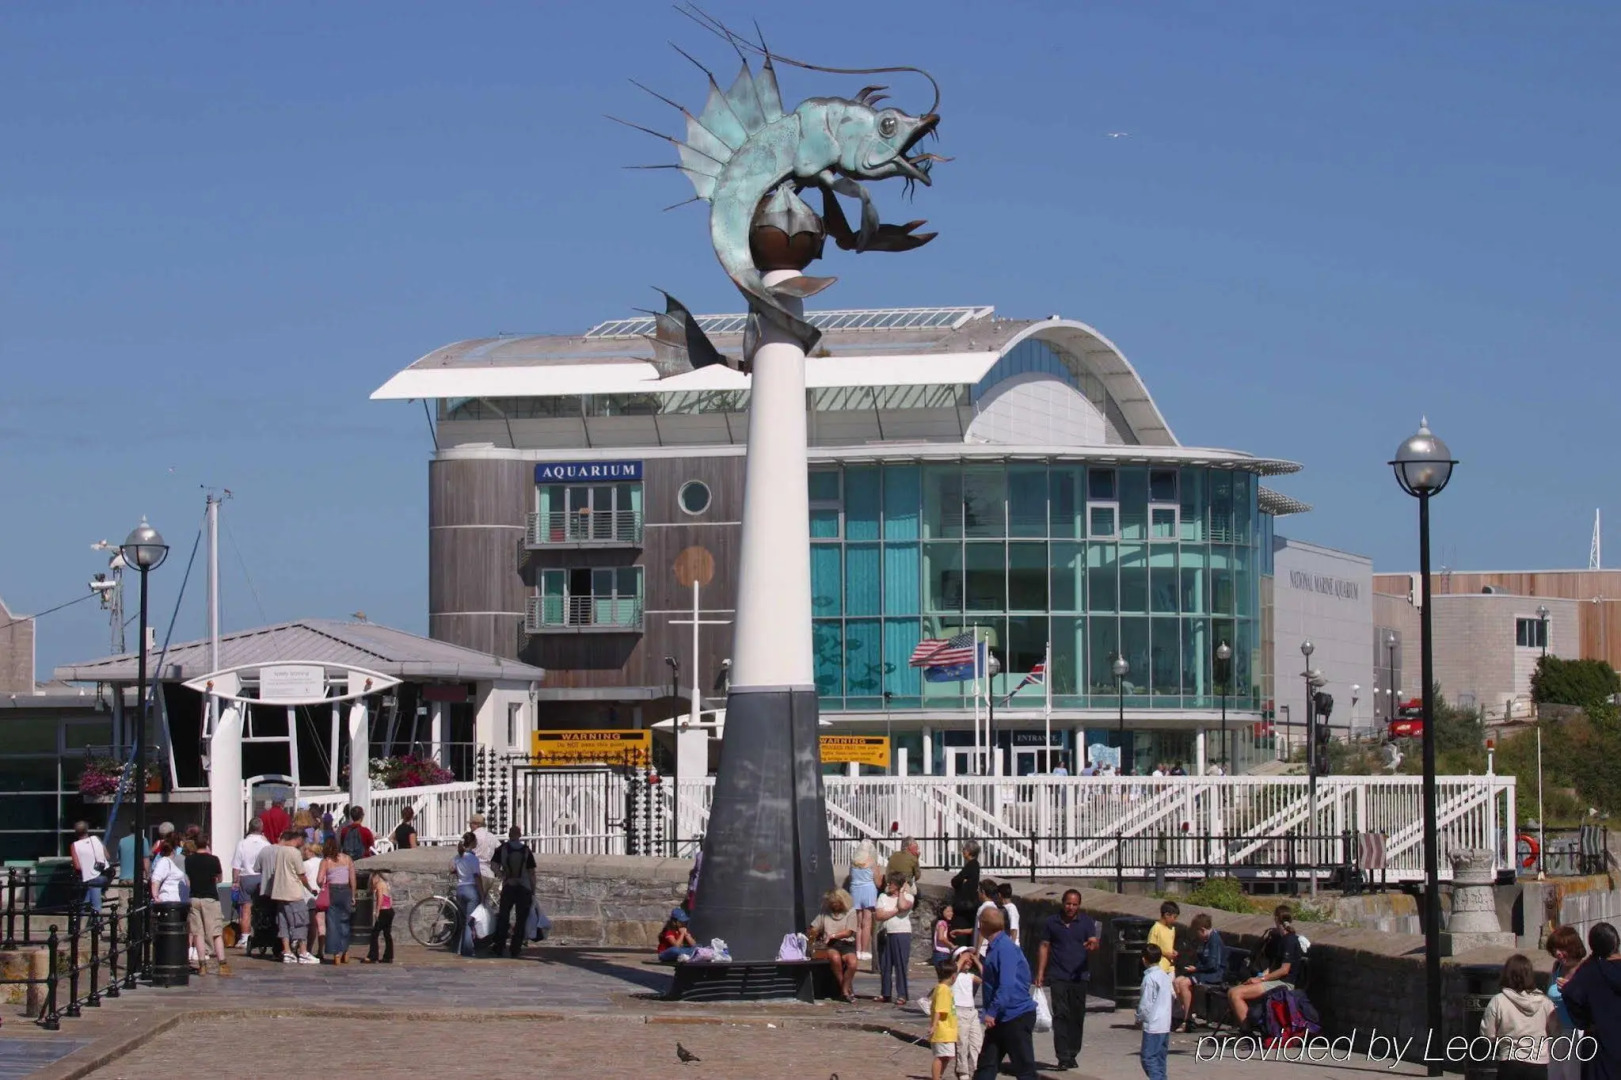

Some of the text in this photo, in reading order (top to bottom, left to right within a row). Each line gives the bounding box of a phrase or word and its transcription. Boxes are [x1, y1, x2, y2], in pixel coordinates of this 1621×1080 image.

[543, 464, 635, 479] AQUARIUM
[1289, 570, 1359, 600] NATIONAL MARINE AQUARIUM
[1017, 734, 1058, 742] ENTRANE
